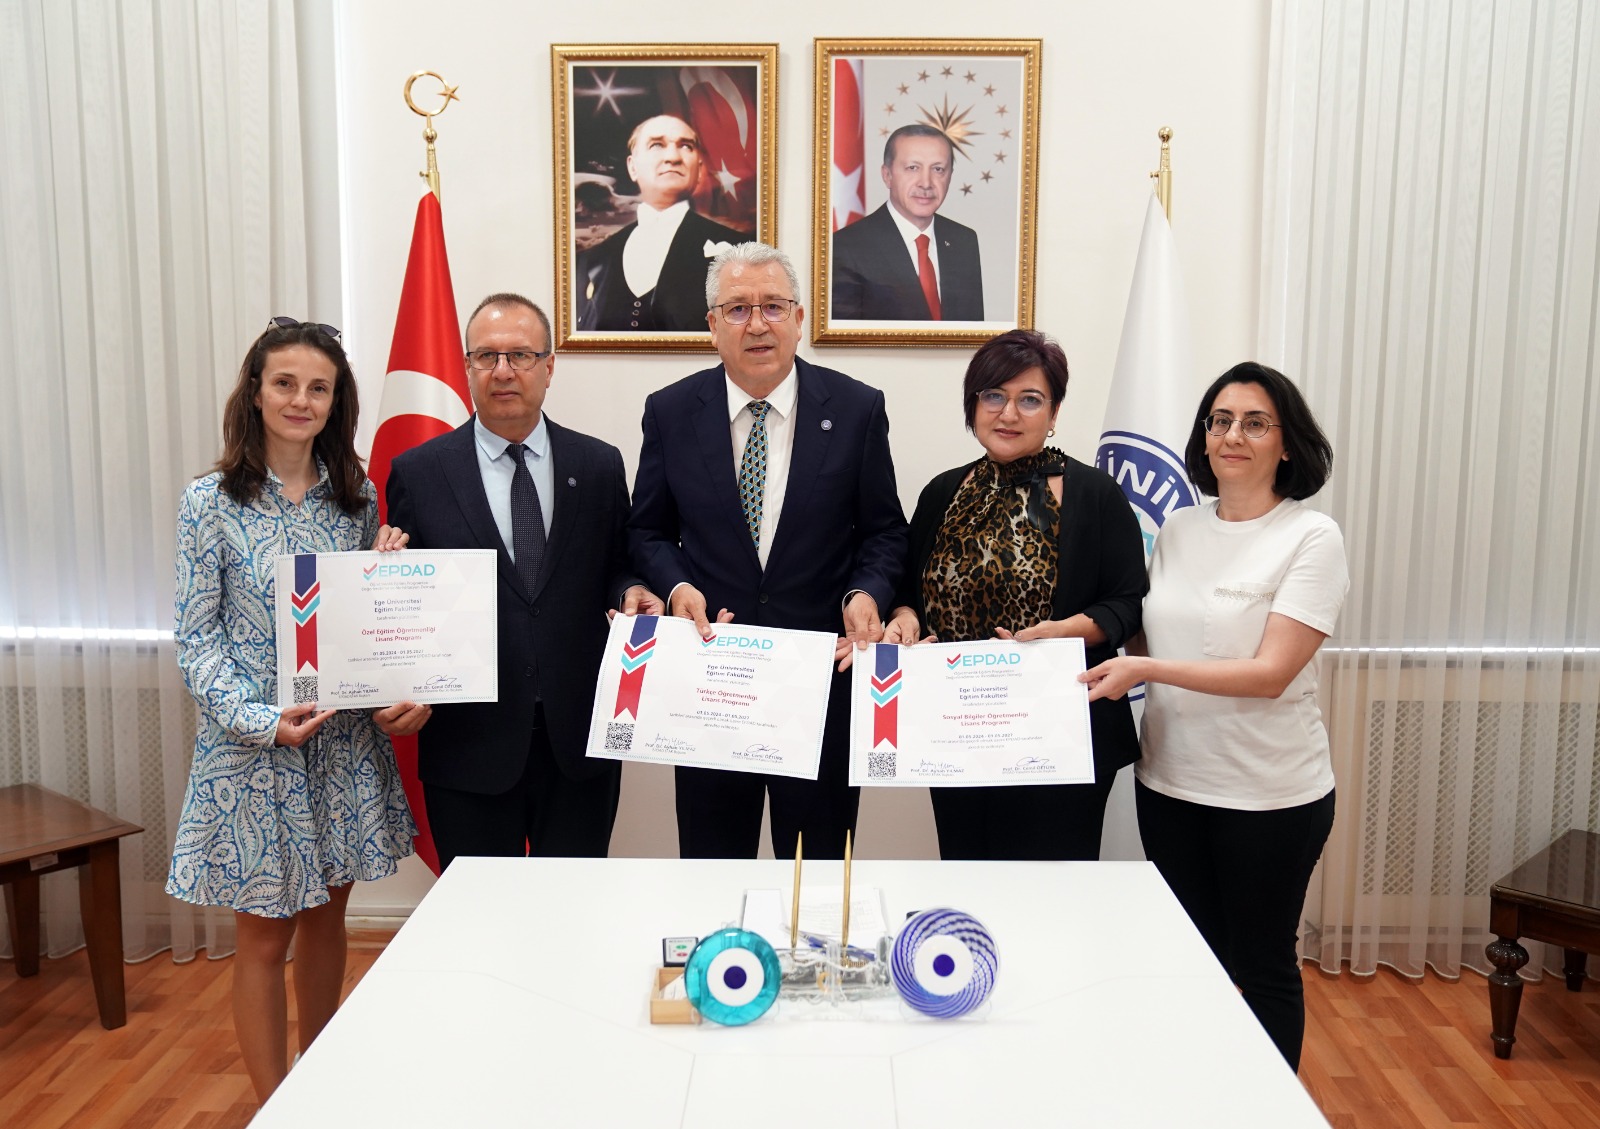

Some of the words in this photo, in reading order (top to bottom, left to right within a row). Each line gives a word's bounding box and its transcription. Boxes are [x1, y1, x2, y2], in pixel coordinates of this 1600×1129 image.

[379, 564, 435, 576] EPDAD
[386, 597, 422, 605] Üniversitesi
[396, 626, 436, 634] Öğretmenliği
[716, 636, 773, 650] EPDAD
[963, 653, 1020, 666] EPDAD
[720, 664, 755, 673] Üniversitesi
[696, 688, 716, 696] Türkçe
[718, 690, 758, 702] Öğretmenliği
[721, 698, 750, 707] Programı
[987, 712, 1029, 720] Öğretmenliği
